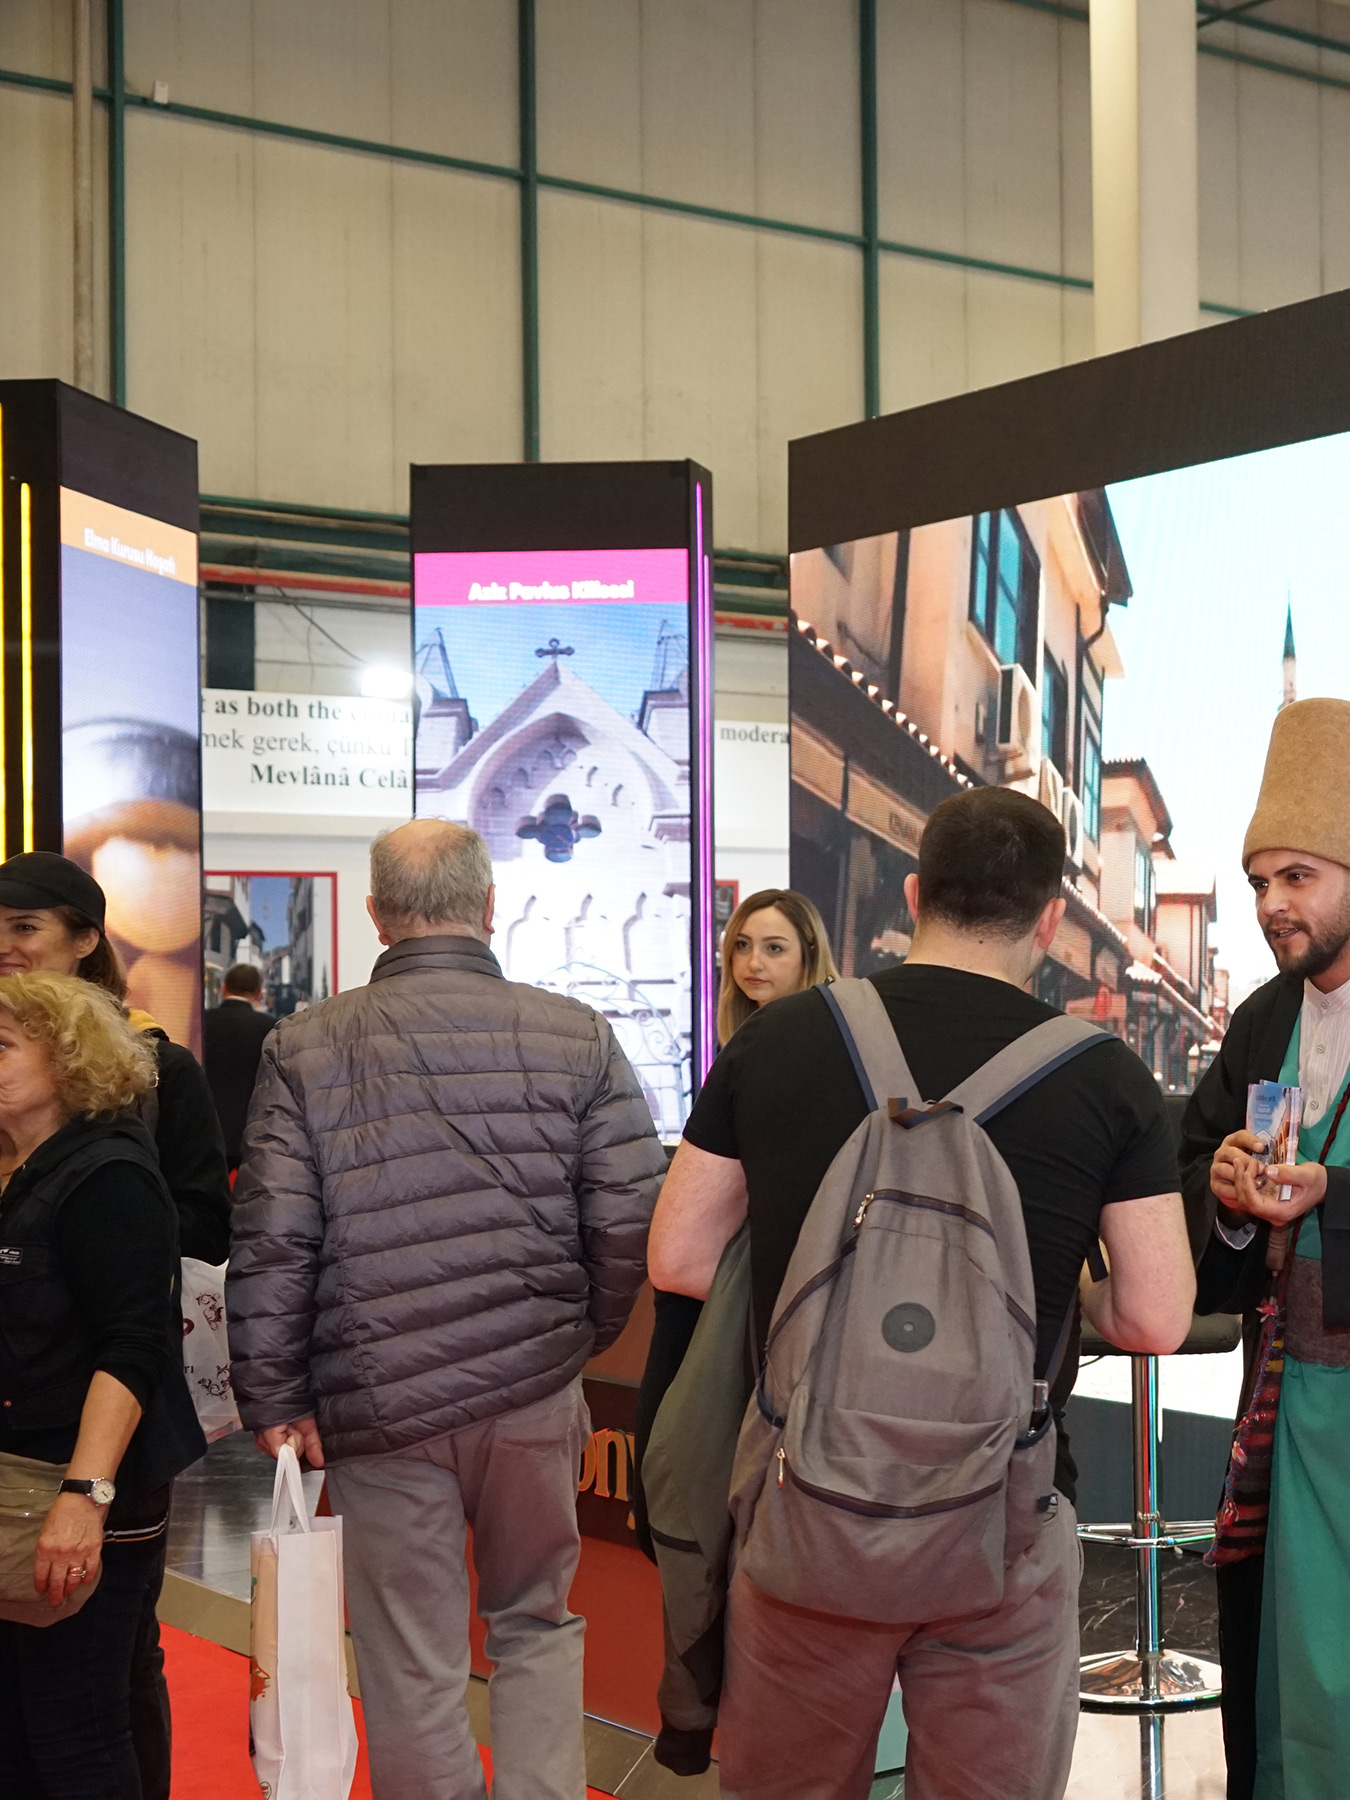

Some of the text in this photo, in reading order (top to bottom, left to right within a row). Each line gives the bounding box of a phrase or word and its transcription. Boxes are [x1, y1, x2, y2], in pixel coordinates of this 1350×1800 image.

[214, 699, 238, 715] as
[247, 696, 299, 718] both
[308, 700, 342, 720] the
[252, 732, 320, 756] gerek,
[250, 763, 350, 786] Mevlânâ
